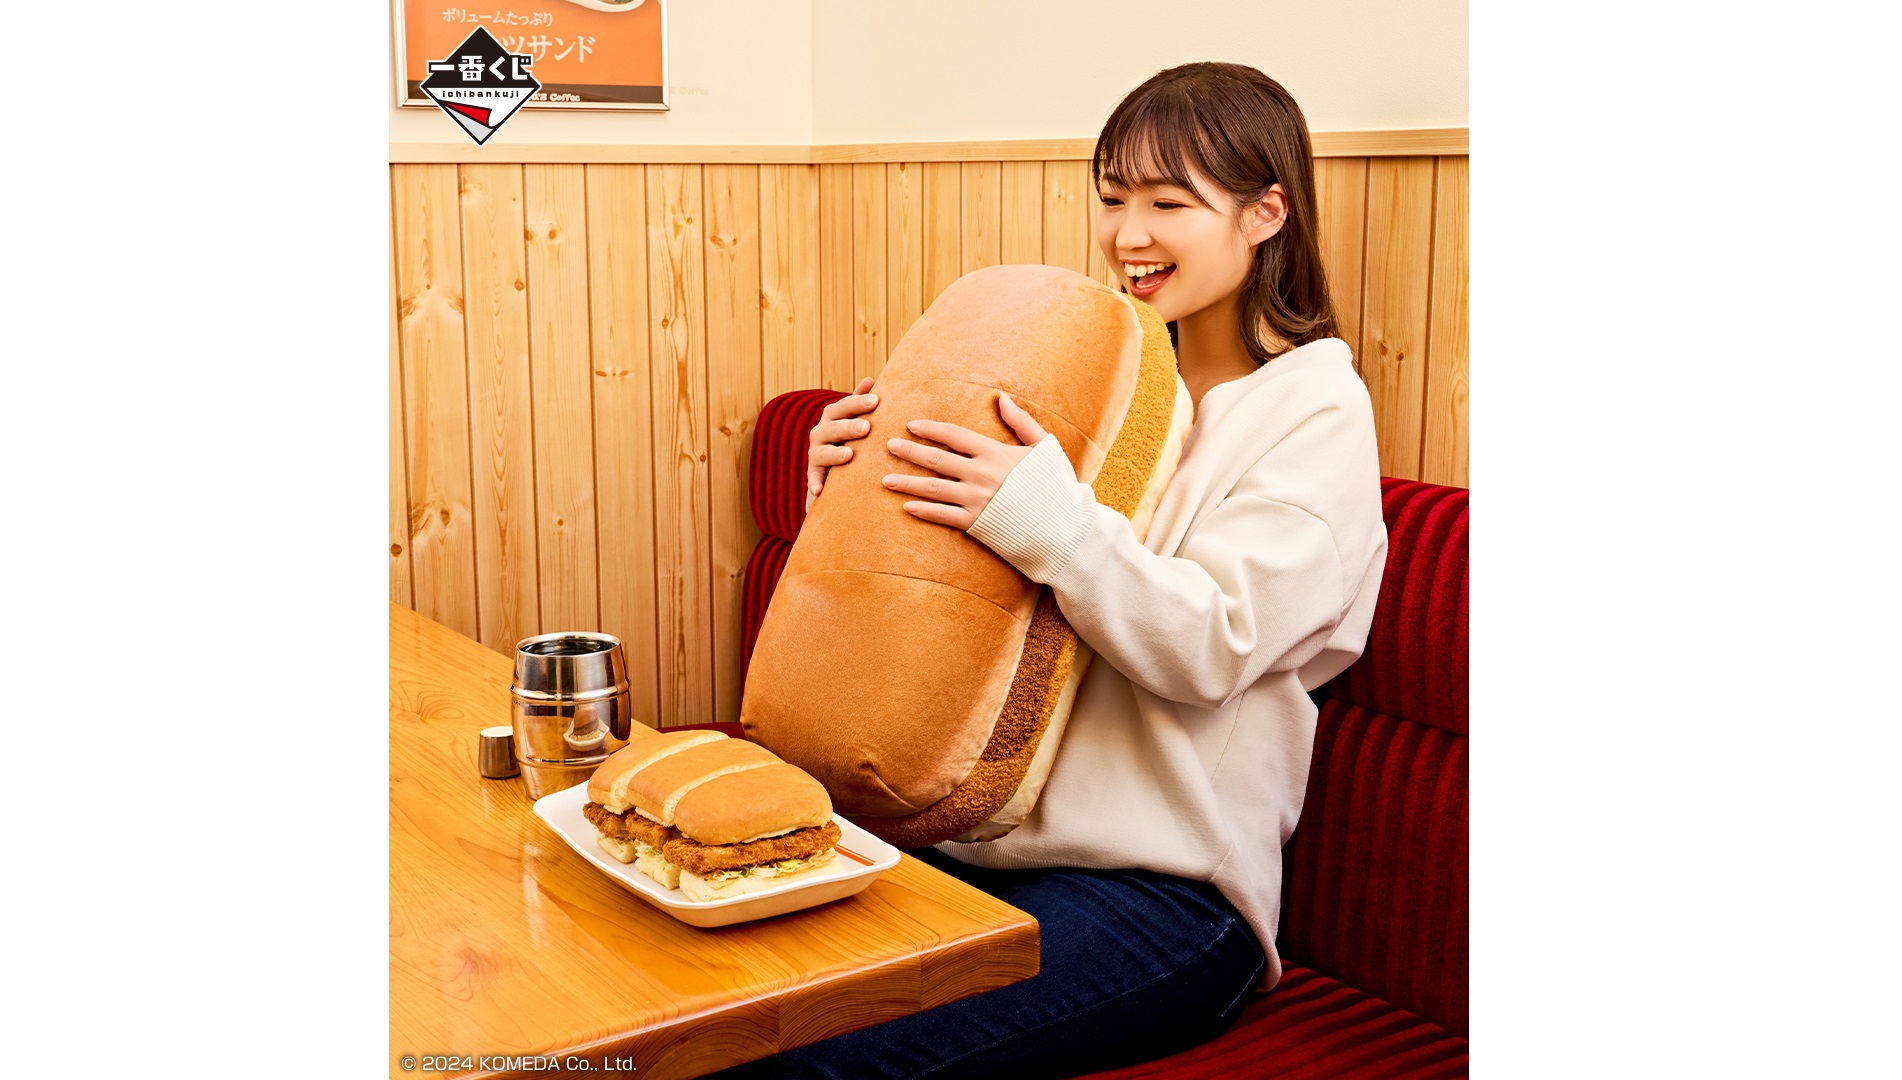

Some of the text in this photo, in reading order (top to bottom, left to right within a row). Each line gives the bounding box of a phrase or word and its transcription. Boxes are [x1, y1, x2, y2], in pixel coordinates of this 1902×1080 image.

[442, 8, 553, 26] ボリュームたっぷり
[501, 34, 596, 63] ツサンド
[549, 93, 580, 102] Coffee
